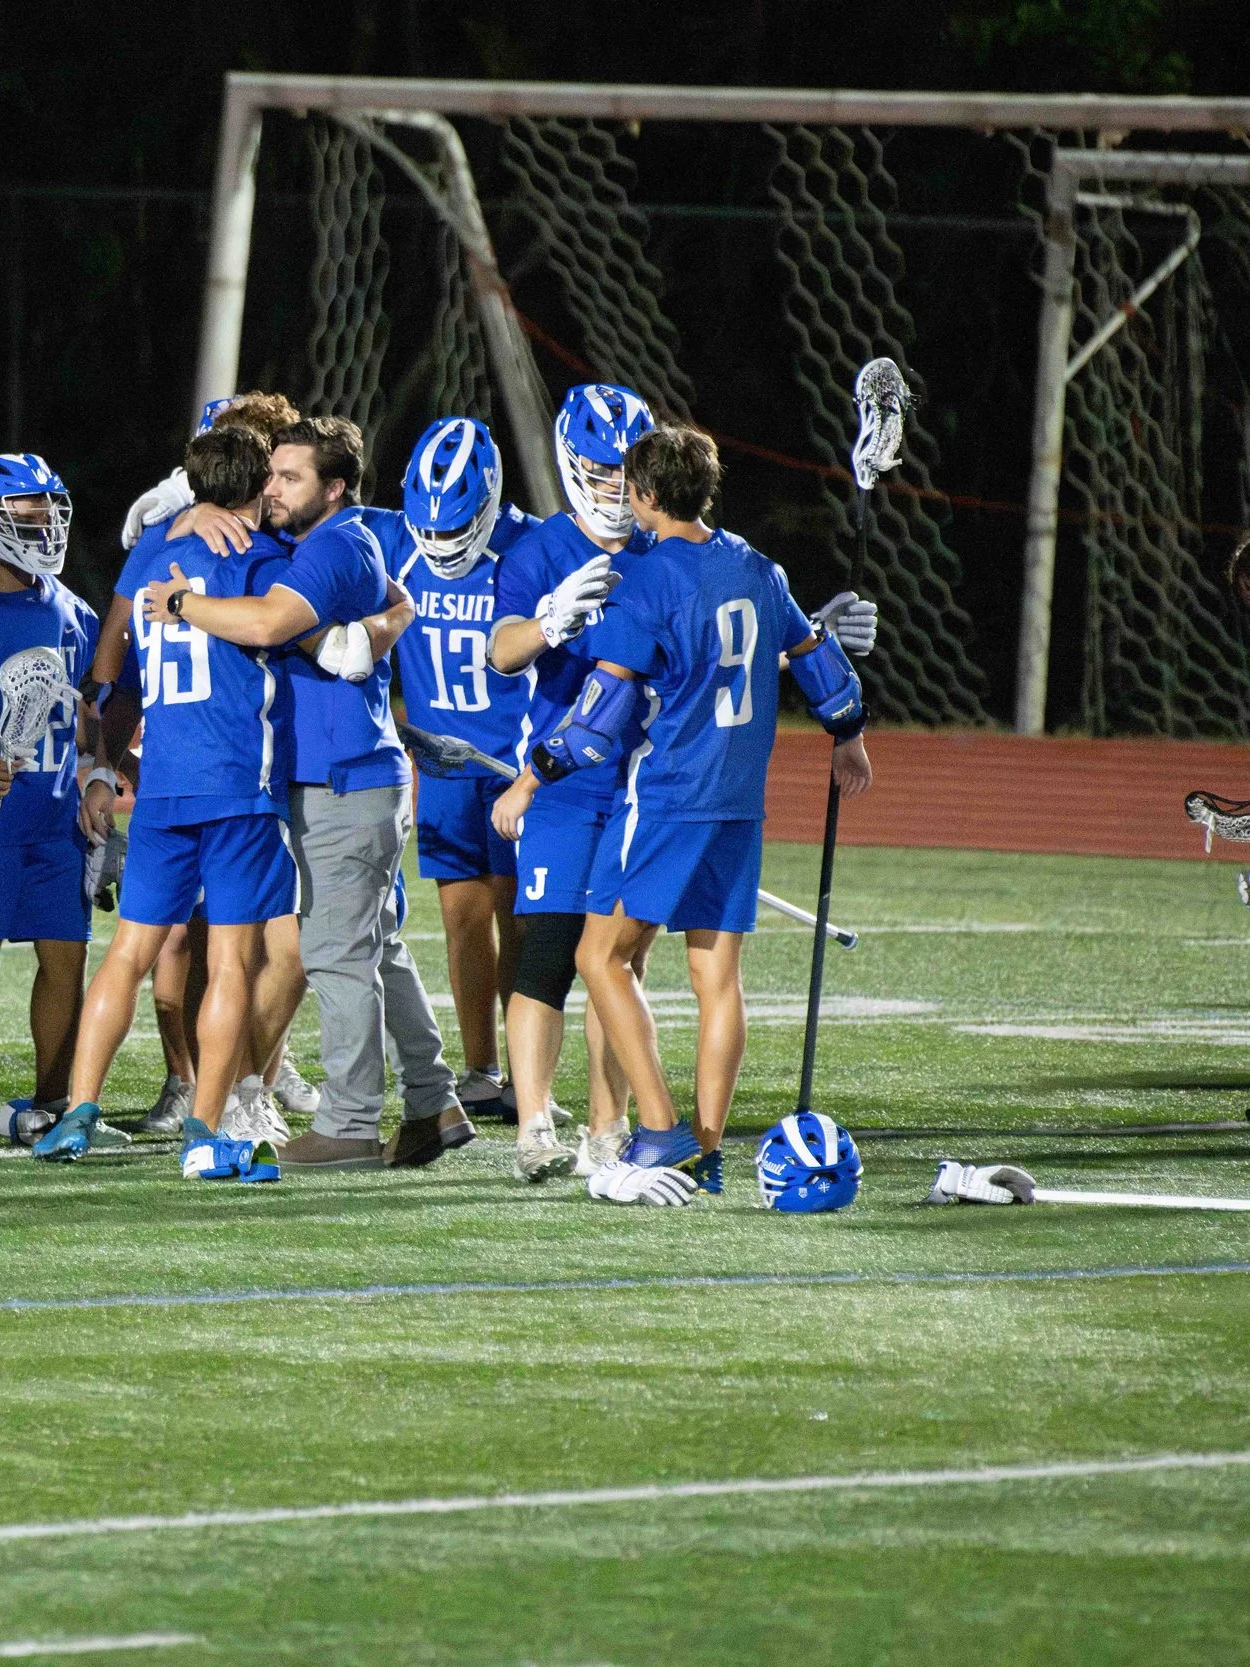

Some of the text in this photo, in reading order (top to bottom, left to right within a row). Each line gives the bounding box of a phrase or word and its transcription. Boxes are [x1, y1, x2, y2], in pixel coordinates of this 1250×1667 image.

[416, 590, 496, 622] JESUIT
[421, 625, 491, 712] 13
[715, 598, 758, 728] 9
[525, 866, 548, 901] J
